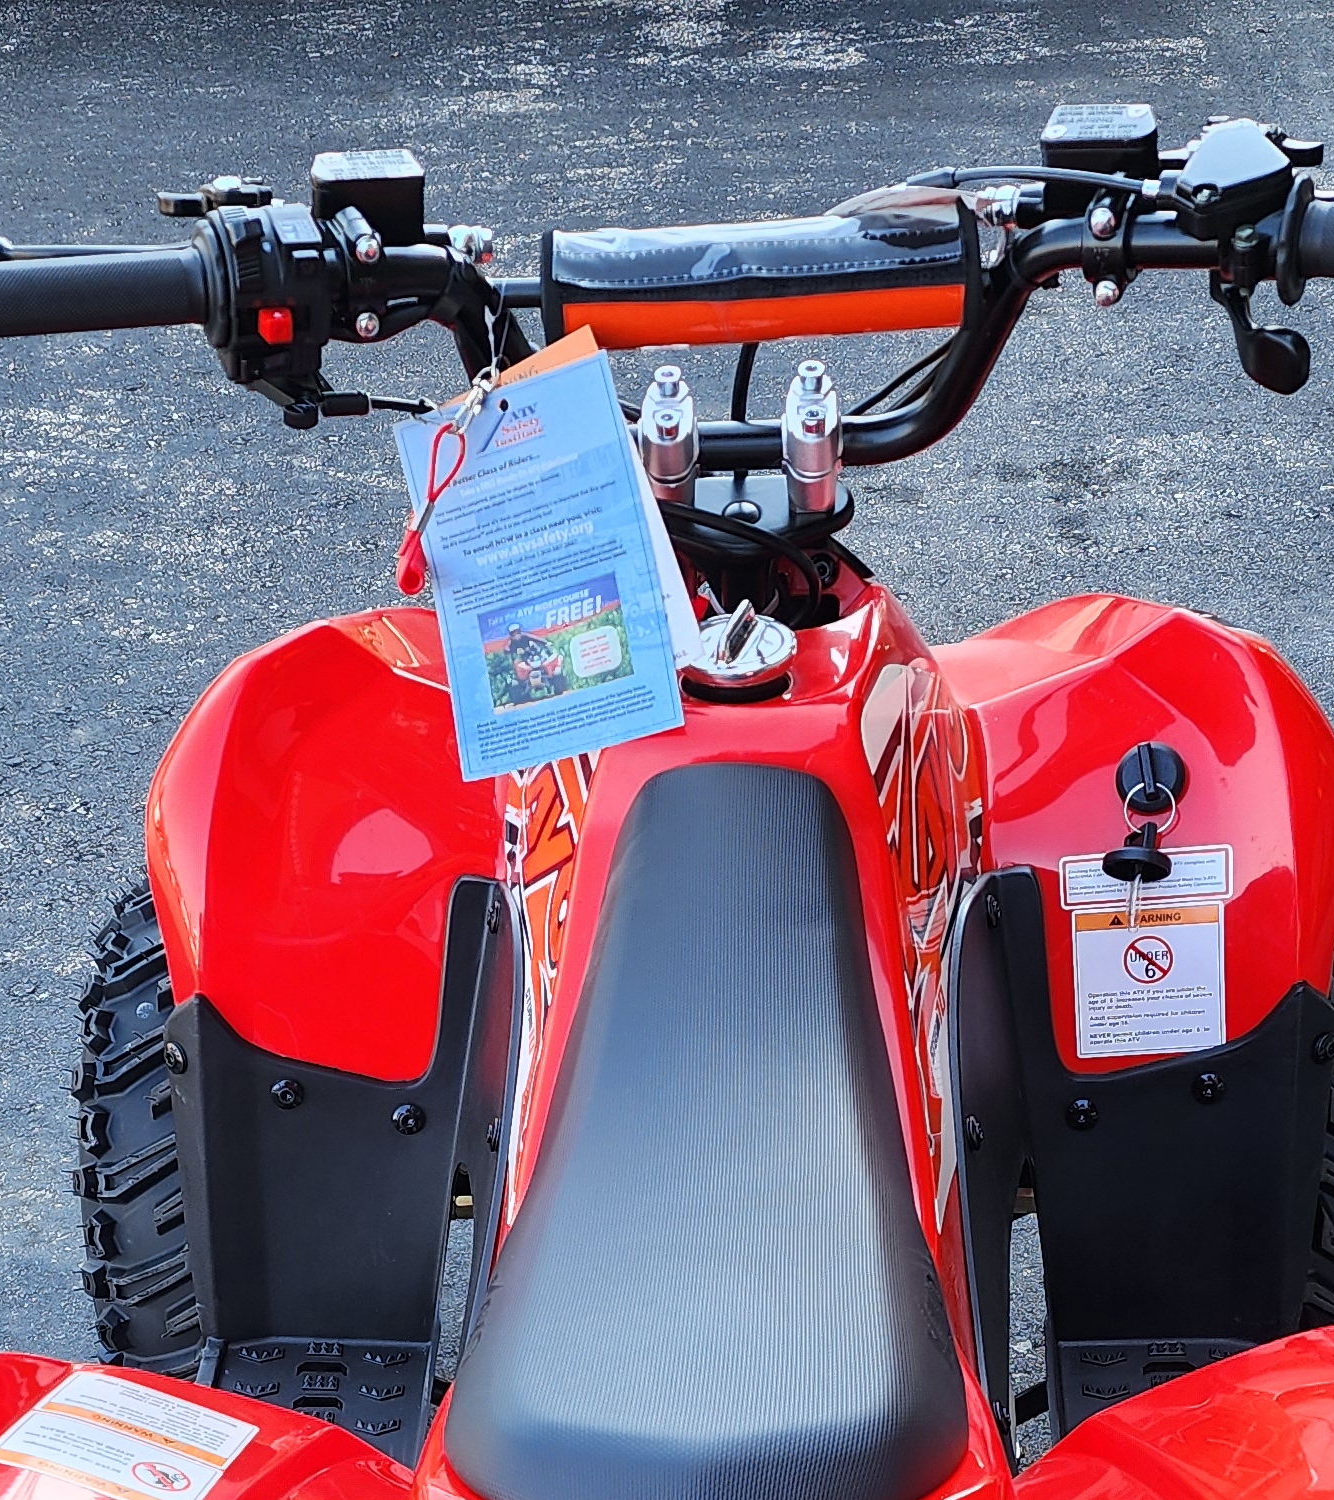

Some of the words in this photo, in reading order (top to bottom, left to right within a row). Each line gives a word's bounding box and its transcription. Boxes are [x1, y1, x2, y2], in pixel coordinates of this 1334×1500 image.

[508, 402, 538, 422] ATV
[501, 416, 539, 435] Safety
[477, 465, 497, 477] Class
[475, 520, 594, 567] www.atvsafety.org
[516, 604, 534, 618] ATV
[542, 595, 604, 629] FREE!
[1138, 912, 1181, 924] ARNING
[1129, 949, 1168, 962] UNDER
[1144, 962, 1156, 978] 6
[89, 1413, 154, 1438] WARNING
[34, 1460, 109, 1488] WARNING
